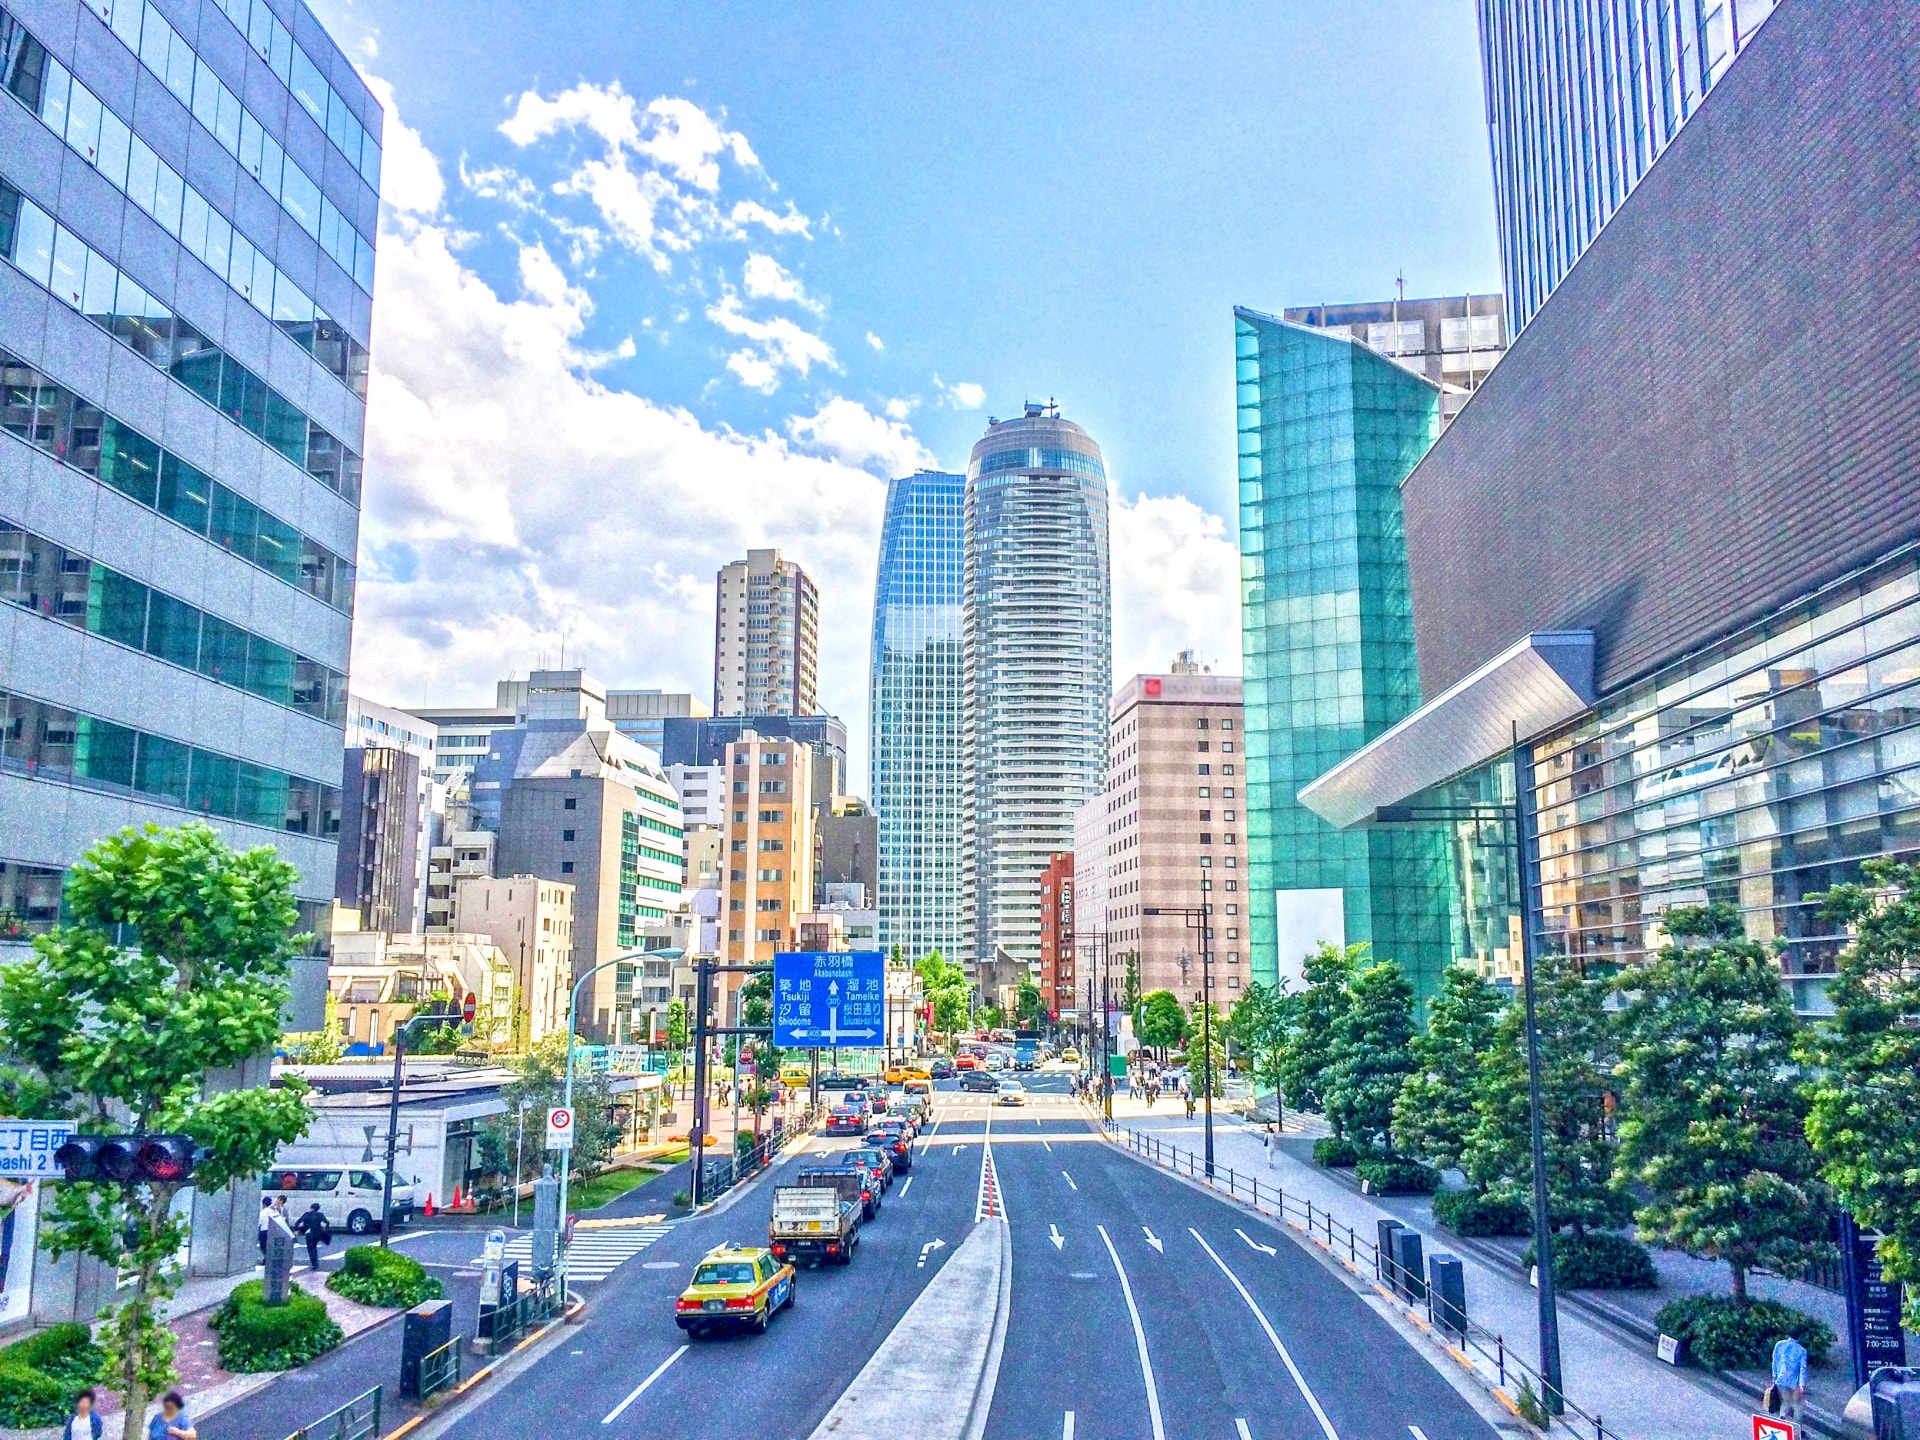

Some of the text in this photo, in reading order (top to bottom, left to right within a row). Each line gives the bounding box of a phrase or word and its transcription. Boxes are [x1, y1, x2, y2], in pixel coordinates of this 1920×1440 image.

[814, 955, 854, 968] 赤羽橋
[779, 979, 812, 991] 築地
[847, 979, 879, 991] 溜池
[782, 992, 810, 1002] Tsukiji
[846, 992, 880, 1001] Tameike
[779, 1003, 812, 1016] 汐留
[843, 1003, 881, 1016] 桜田通り
[778, 1017, 812, 1026] Shiodome
[0, 1154, 32, 1170] ashi
[37, 1154, 47, 1170] 2
[1864, 1322, 1873, 1331] 24
[1866, 1340, 1899, 1348] 7:00-23:00
